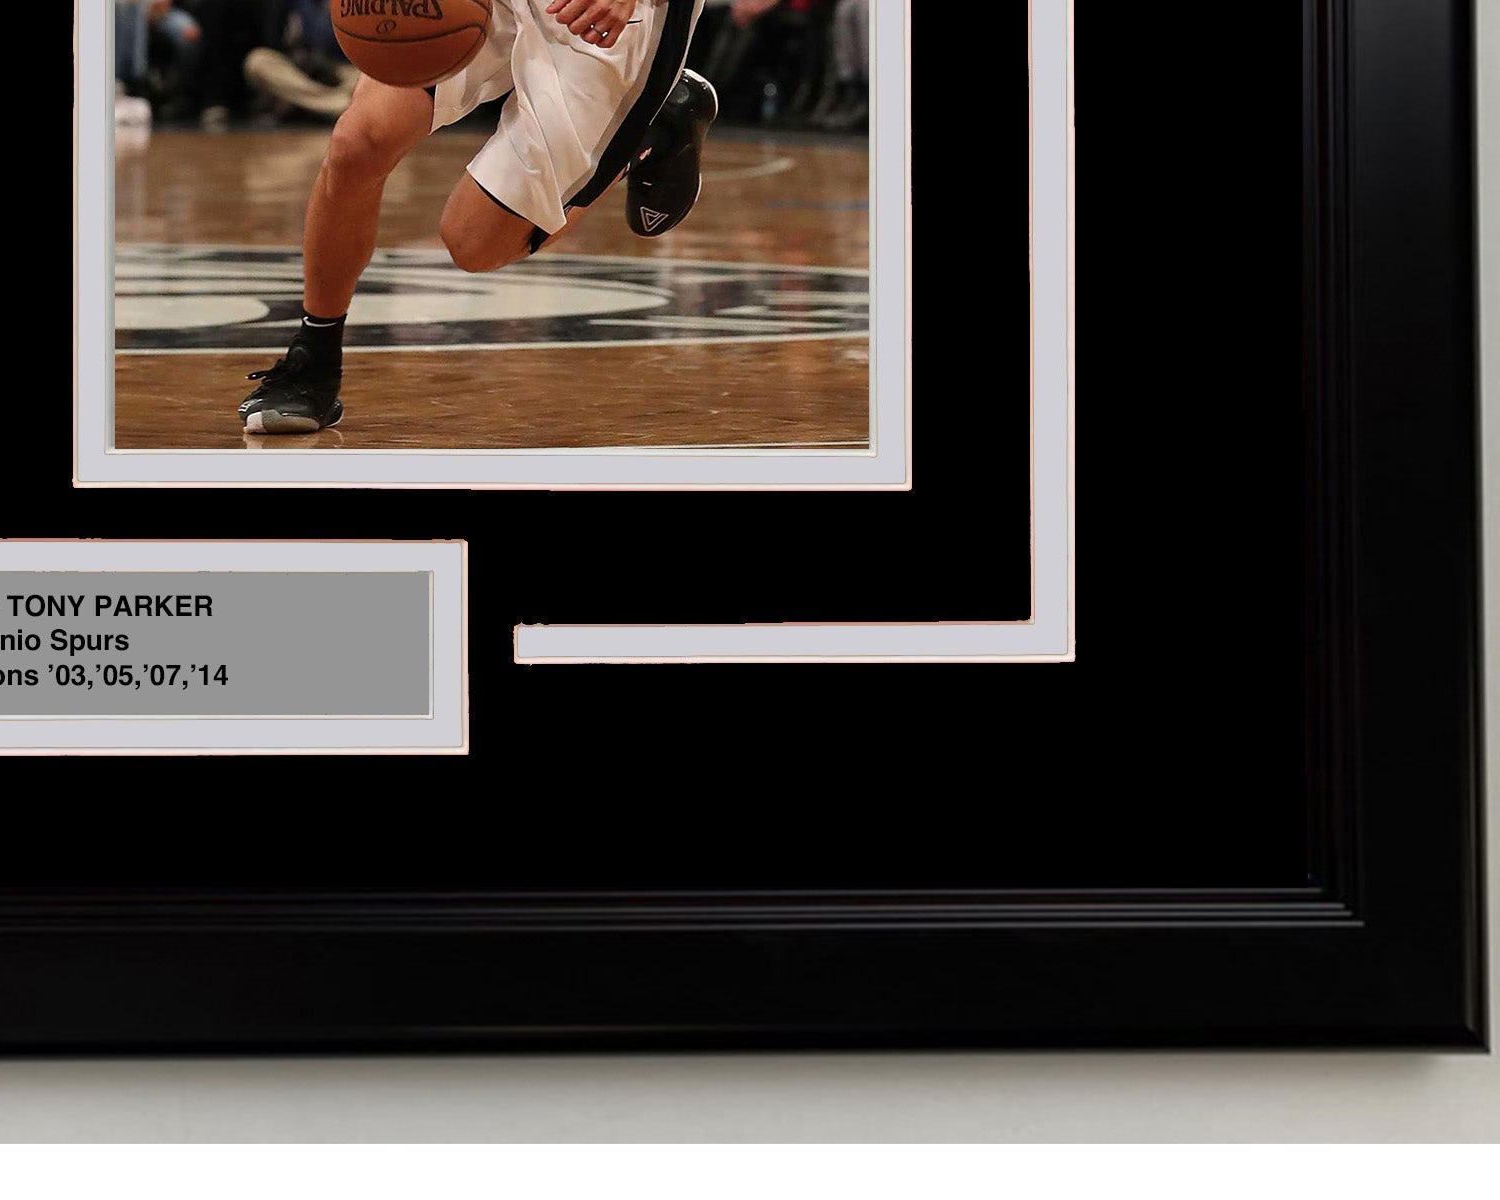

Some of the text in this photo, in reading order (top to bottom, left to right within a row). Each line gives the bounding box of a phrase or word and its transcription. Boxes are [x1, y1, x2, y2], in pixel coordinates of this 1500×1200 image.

[6, 594, 85, 618] TONY
[95, 594, 213, 617] PARKER
[50, 628, 130, 657] Spurs
